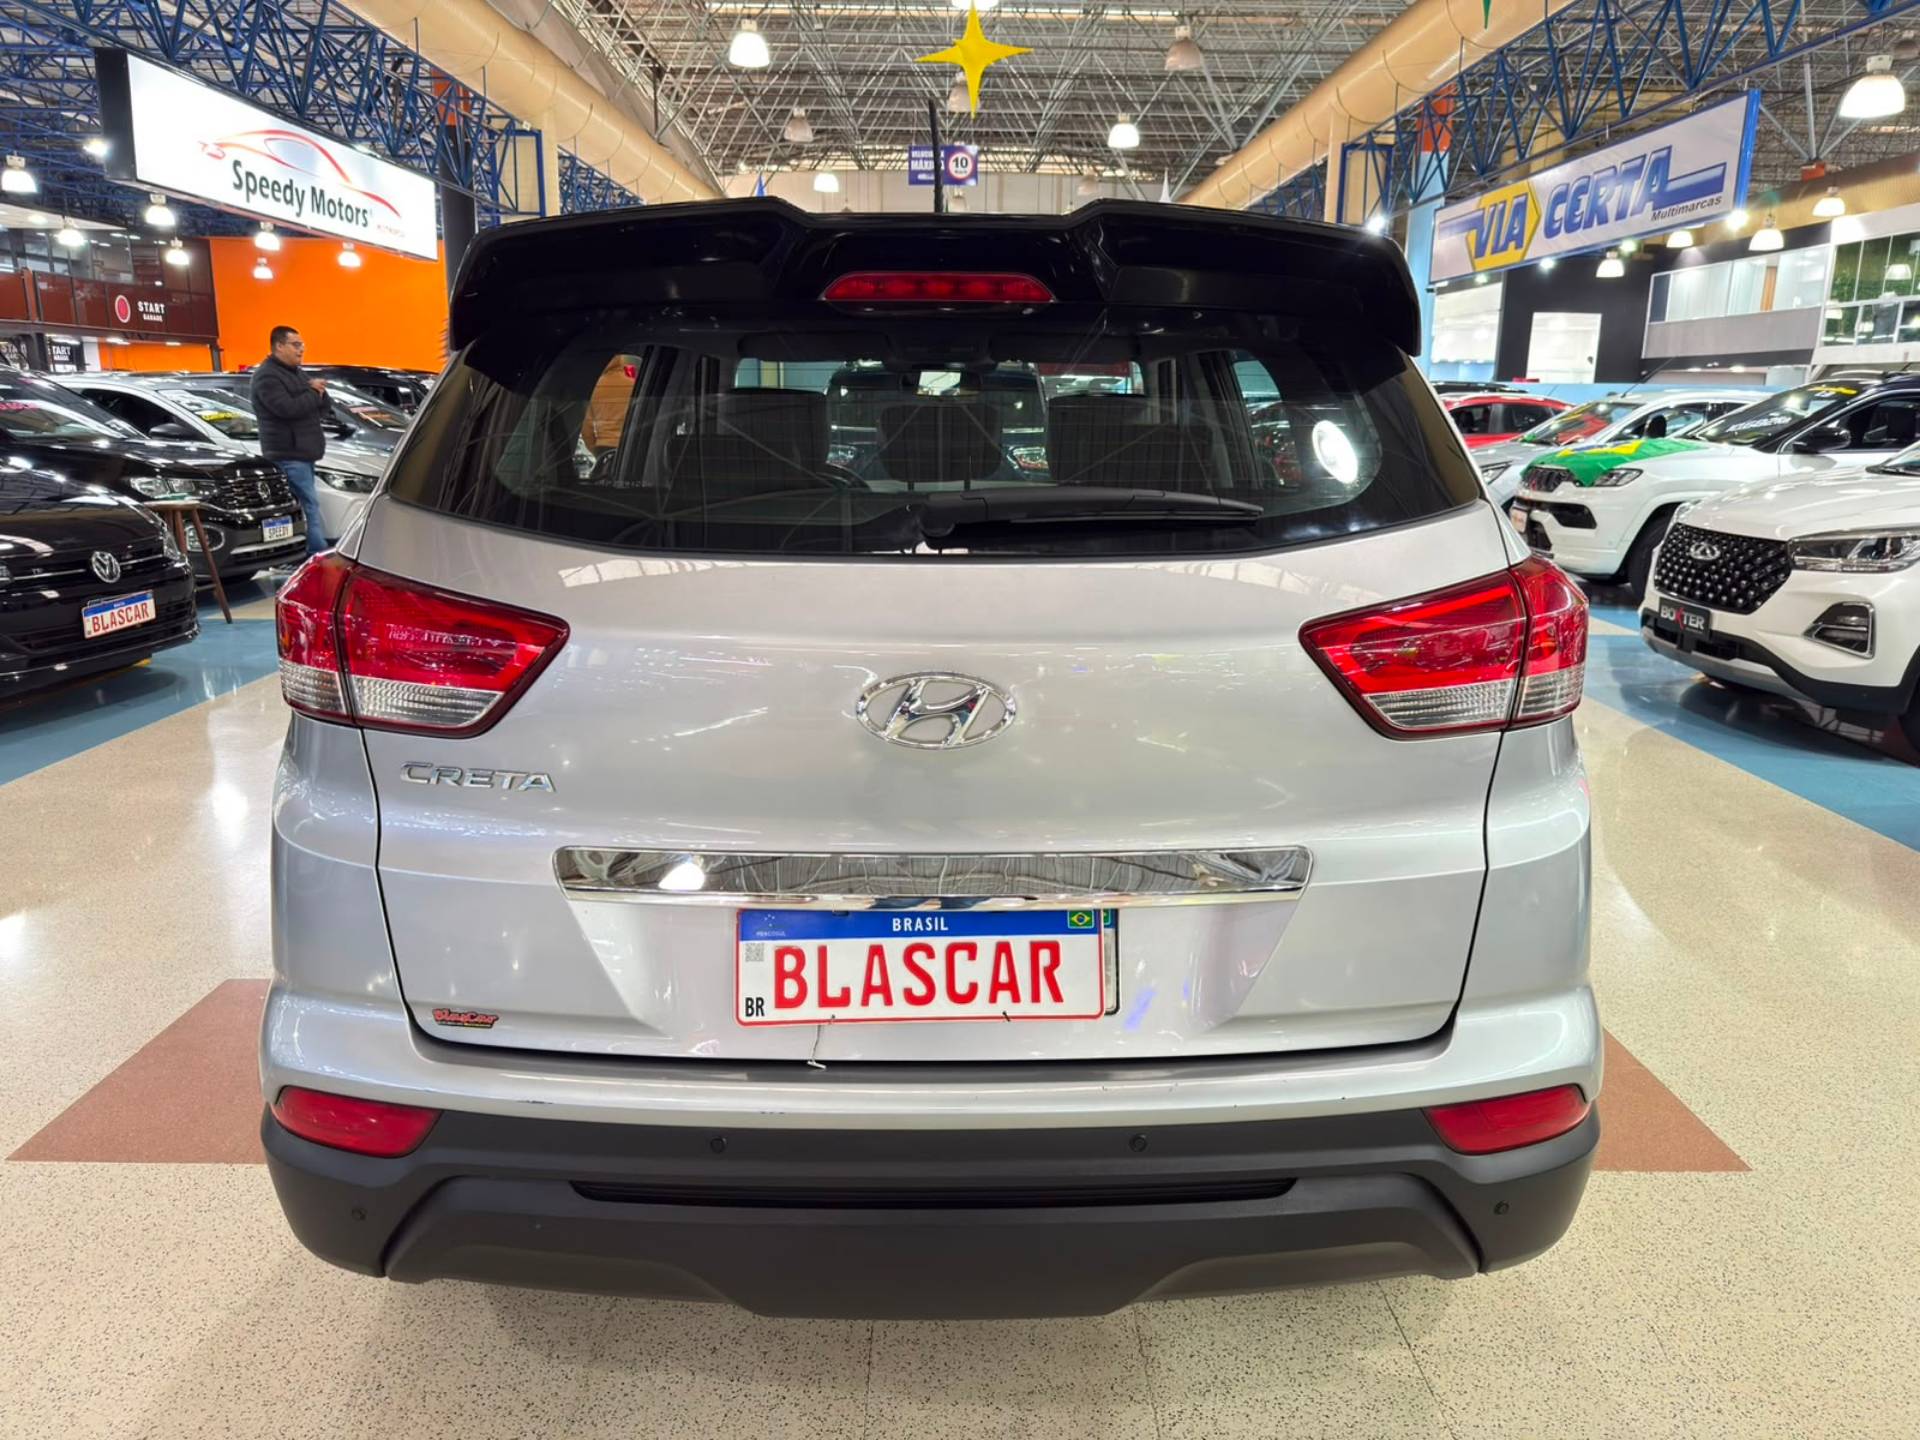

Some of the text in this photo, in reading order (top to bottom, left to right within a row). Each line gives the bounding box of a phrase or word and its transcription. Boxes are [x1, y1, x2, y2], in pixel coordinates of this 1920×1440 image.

[952, 157, 968, 168] 10
[232, 159, 369, 228] Speedy Motors
[1464, 145, 1674, 260] VIA CERTA
[1651, 196, 1722, 221] Multimarcas
[137, 301, 165, 314] START
[92, 602, 149, 633] BLASCAR
[400, 761, 557, 793] CRETA
[891, 917, 949, 932] BRASIL
[773, 940, 1064, 1010] BLASCAR
[745, 996, 765, 1017] BR
